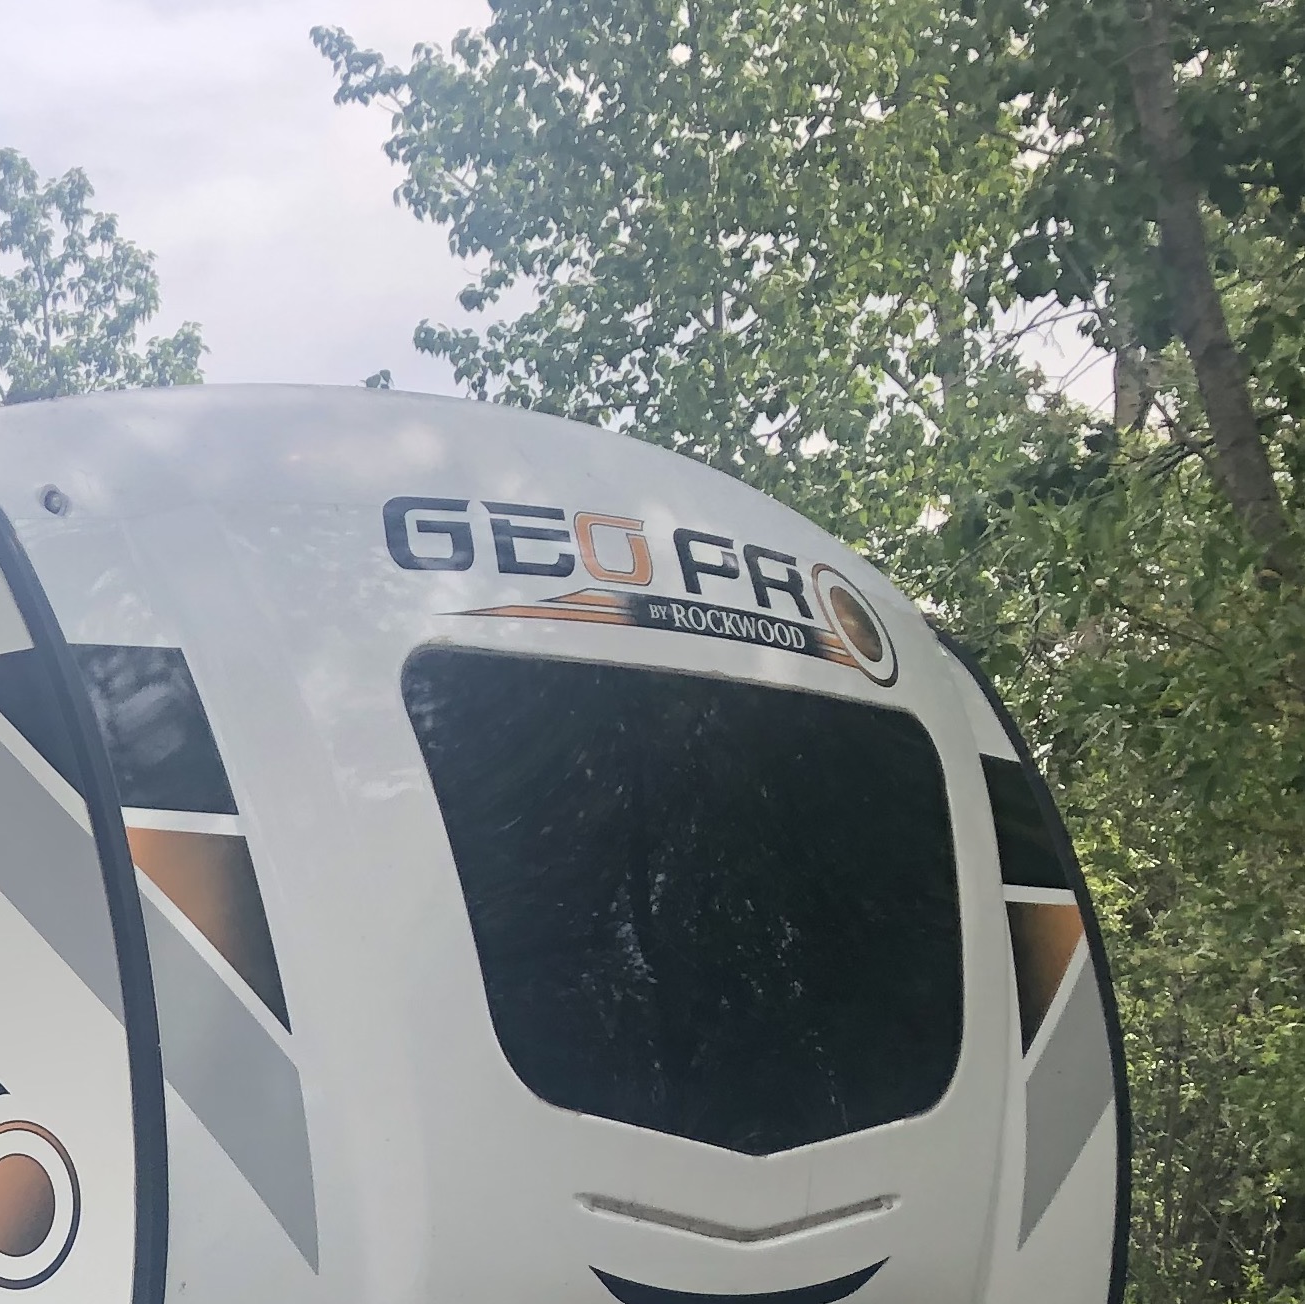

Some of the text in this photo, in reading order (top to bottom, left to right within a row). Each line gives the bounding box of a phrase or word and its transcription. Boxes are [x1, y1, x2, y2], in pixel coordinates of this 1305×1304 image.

[383, 496, 653, 586] GEO
[648, 602, 806, 651] BY ROCKWOOD
